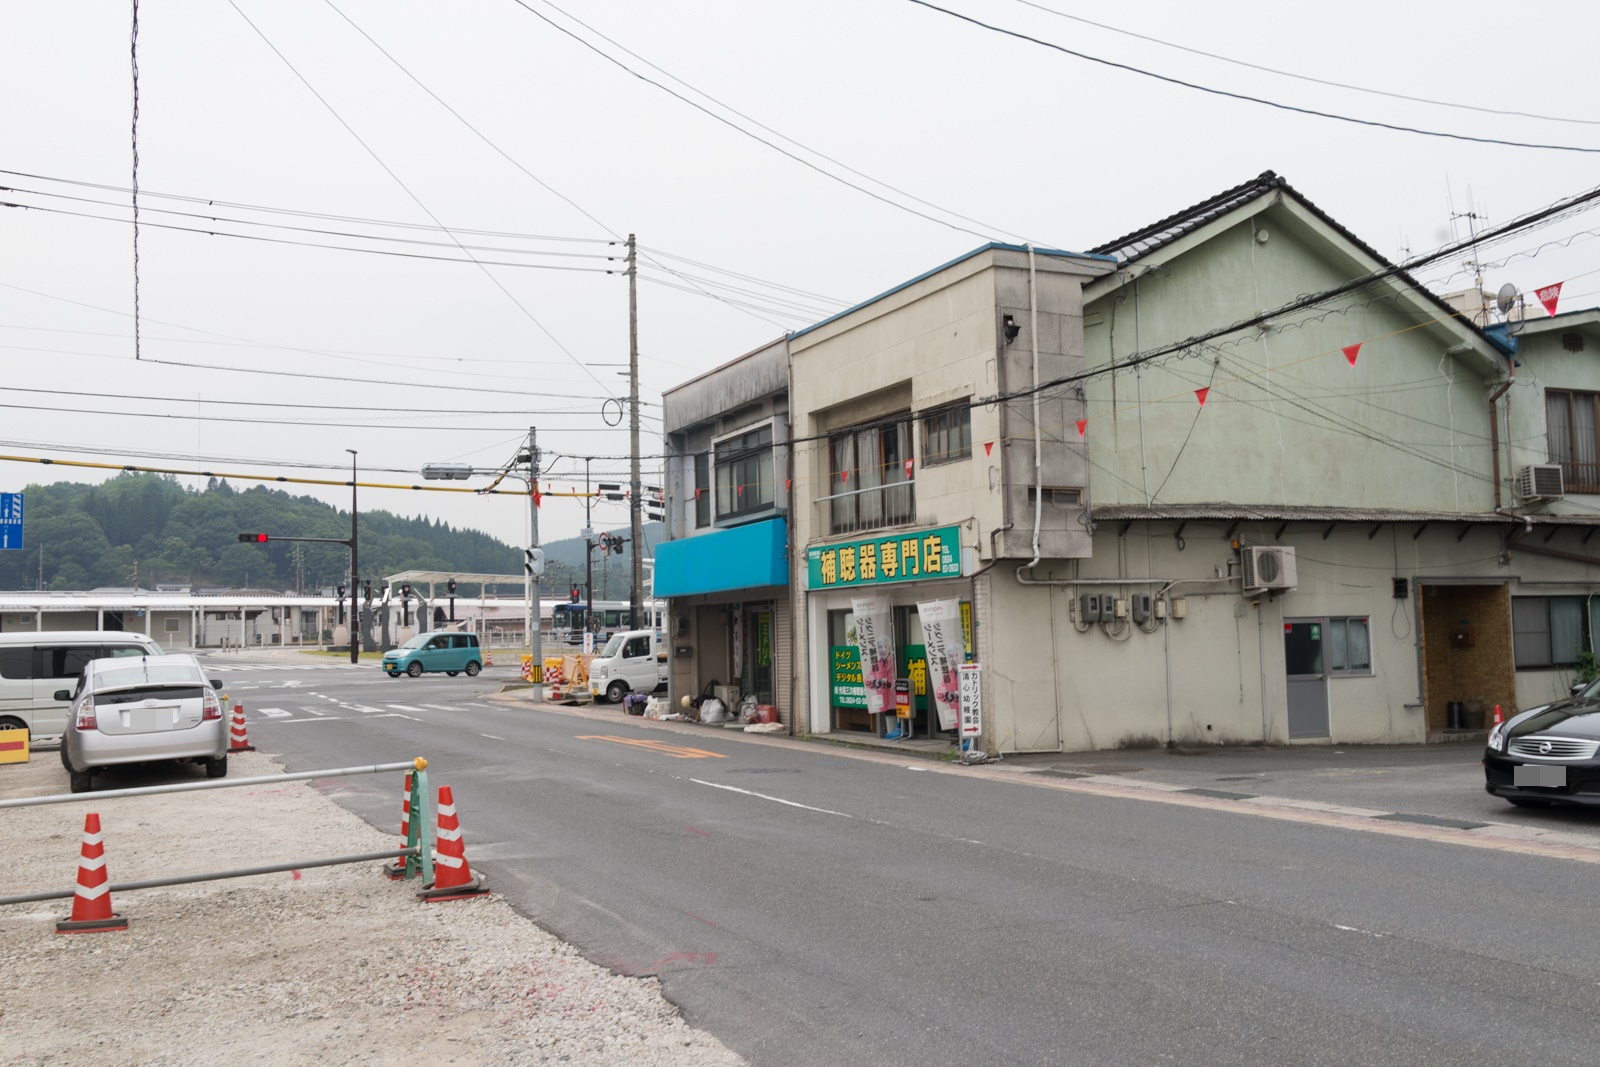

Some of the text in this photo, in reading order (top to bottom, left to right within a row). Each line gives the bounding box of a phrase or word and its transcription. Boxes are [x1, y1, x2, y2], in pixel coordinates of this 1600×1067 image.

[1540, 286, 1559, 301] 危険
[820, 534, 941, 584] 補聴器専門店
[835, 650, 851, 660] ドイツ
[835, 661, 862, 670] シーメンス
[907, 657, 926, 696] 補
[971, 672, 980, 724] カトリック教会
